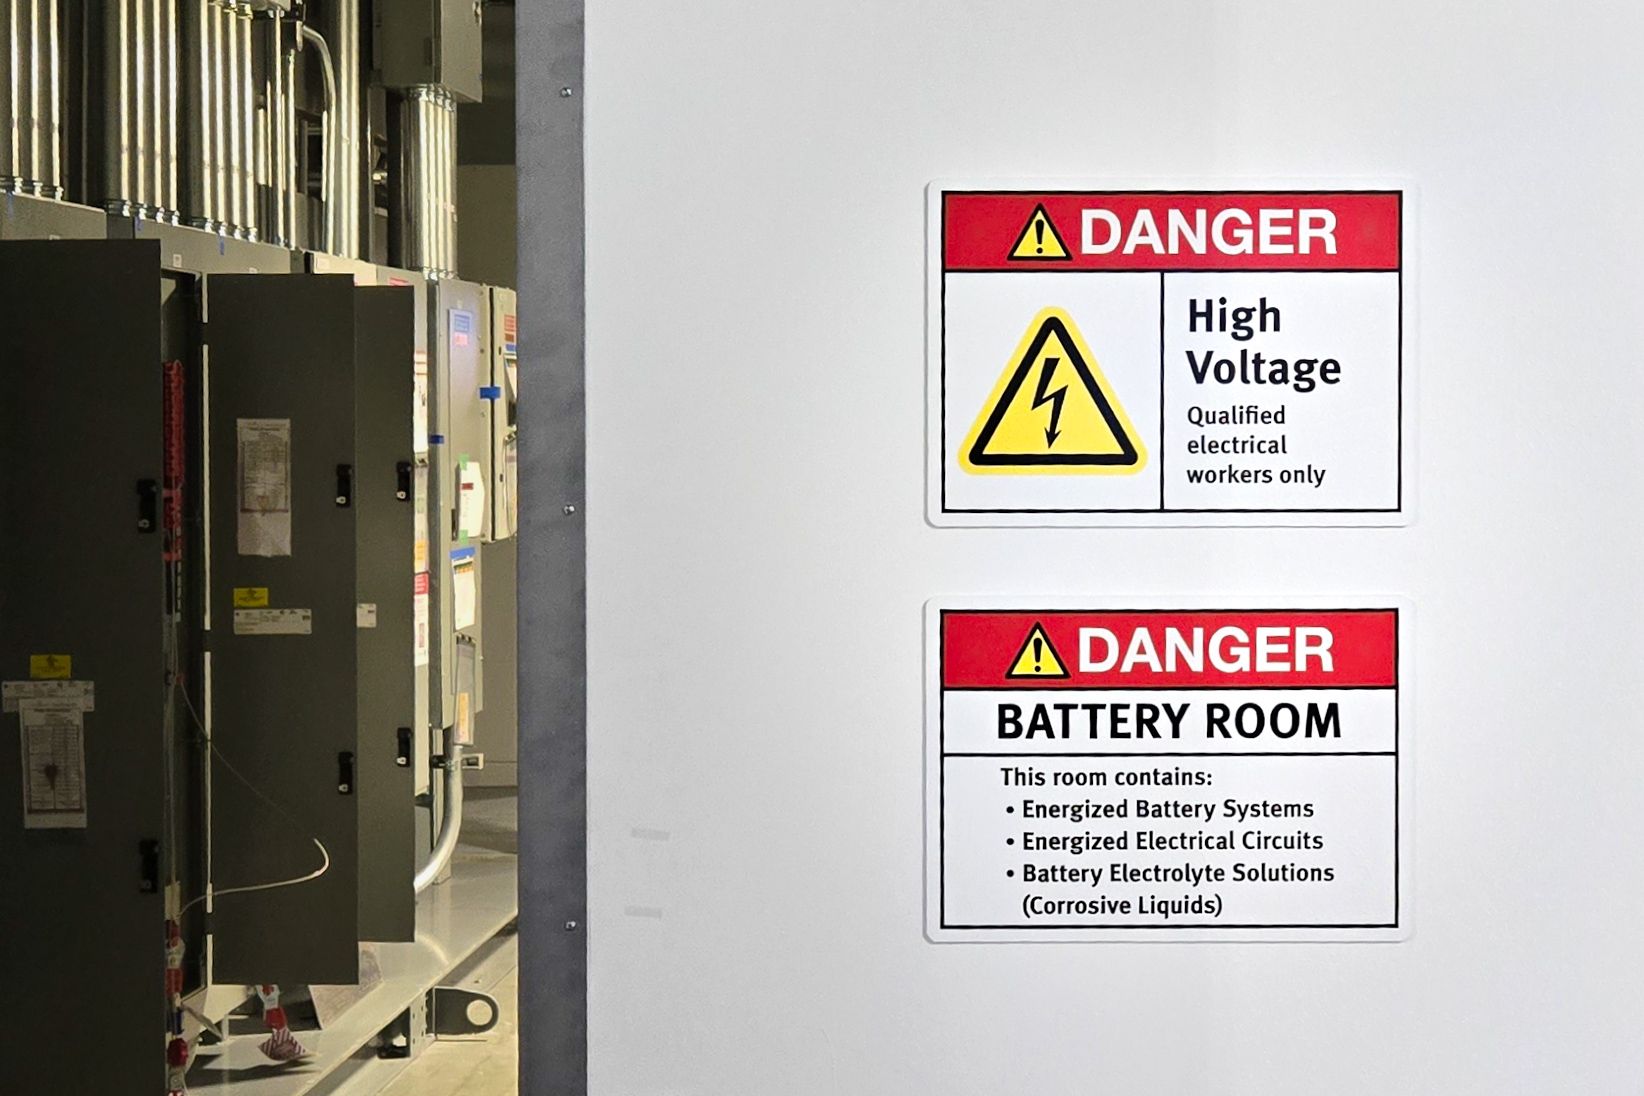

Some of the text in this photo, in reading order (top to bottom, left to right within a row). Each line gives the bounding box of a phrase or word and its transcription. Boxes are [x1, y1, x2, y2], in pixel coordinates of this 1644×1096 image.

[1081, 207, 1338, 256] DANGER
[1189, 297, 1281, 341] High
[1186, 349, 1341, 393] Voltage
[1187, 405, 1285, 427] Qualified
[1187, 434, 1287, 455] electrical
[1187, 464, 1326, 487] workers only
[1078, 626, 1334, 674] DANGER
[998, 702, 1341, 739] BATTERY ROOM
[1001, 767, 1212, 787] This room contains:
[1023, 799, 1314, 823] Energized Battery Systems
[1023, 831, 1324, 854] Energized Electrical Circuits
[1023, 863, 1335, 886] Battery Electrolyte Solutions
[1022, 894, 1223, 918] (Corrosive Liquids)
